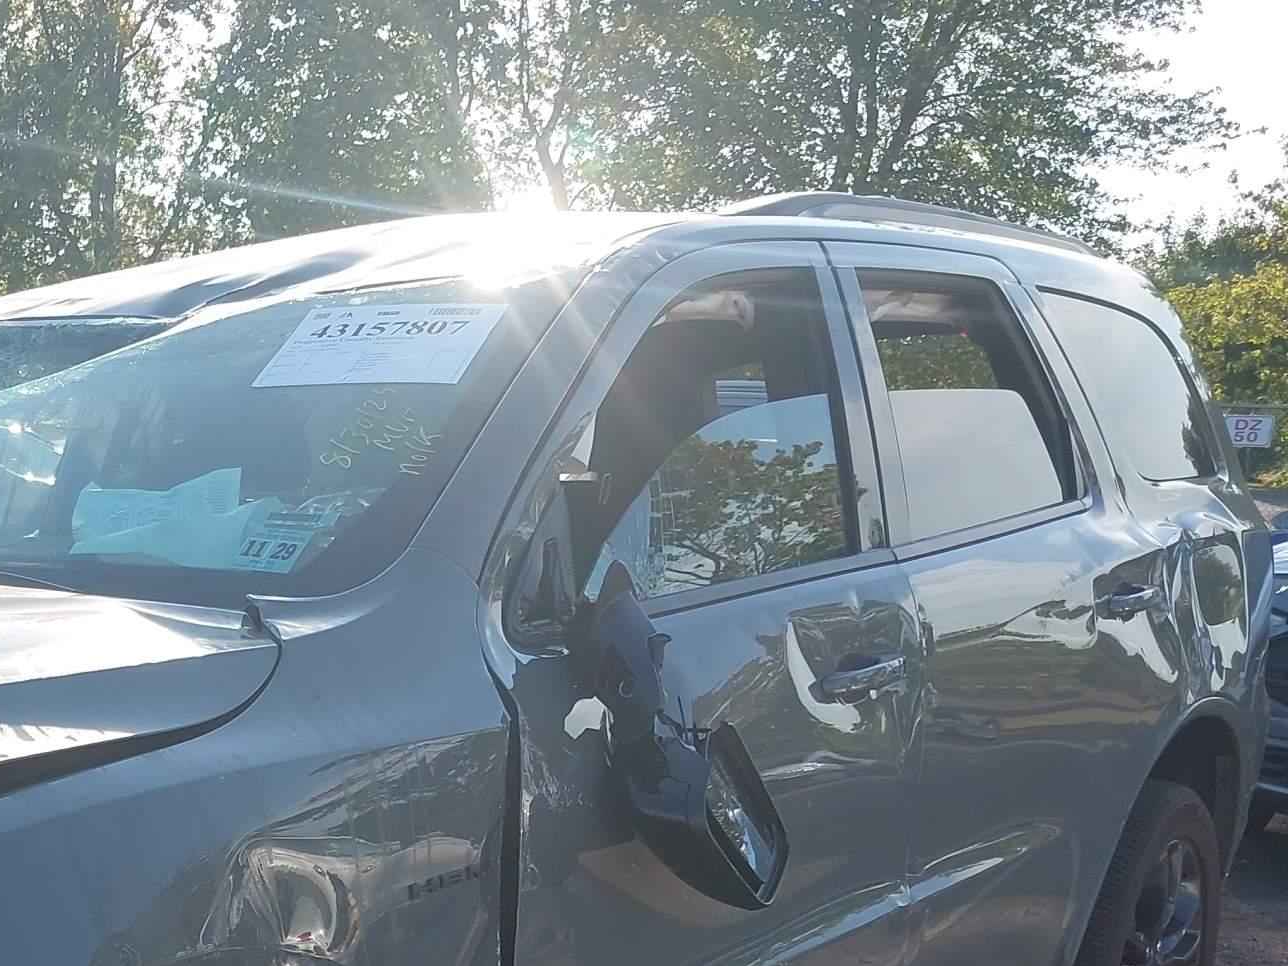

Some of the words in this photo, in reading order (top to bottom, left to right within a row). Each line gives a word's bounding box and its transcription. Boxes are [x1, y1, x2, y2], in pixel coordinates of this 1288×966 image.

[310, 320, 471, 339] 43157807
[1234, 419, 1263, 431] DZ
[1233, 431, 1259, 443] 50
[239, 540, 269, 558] 11
[269, 542, 298, 561] 29
